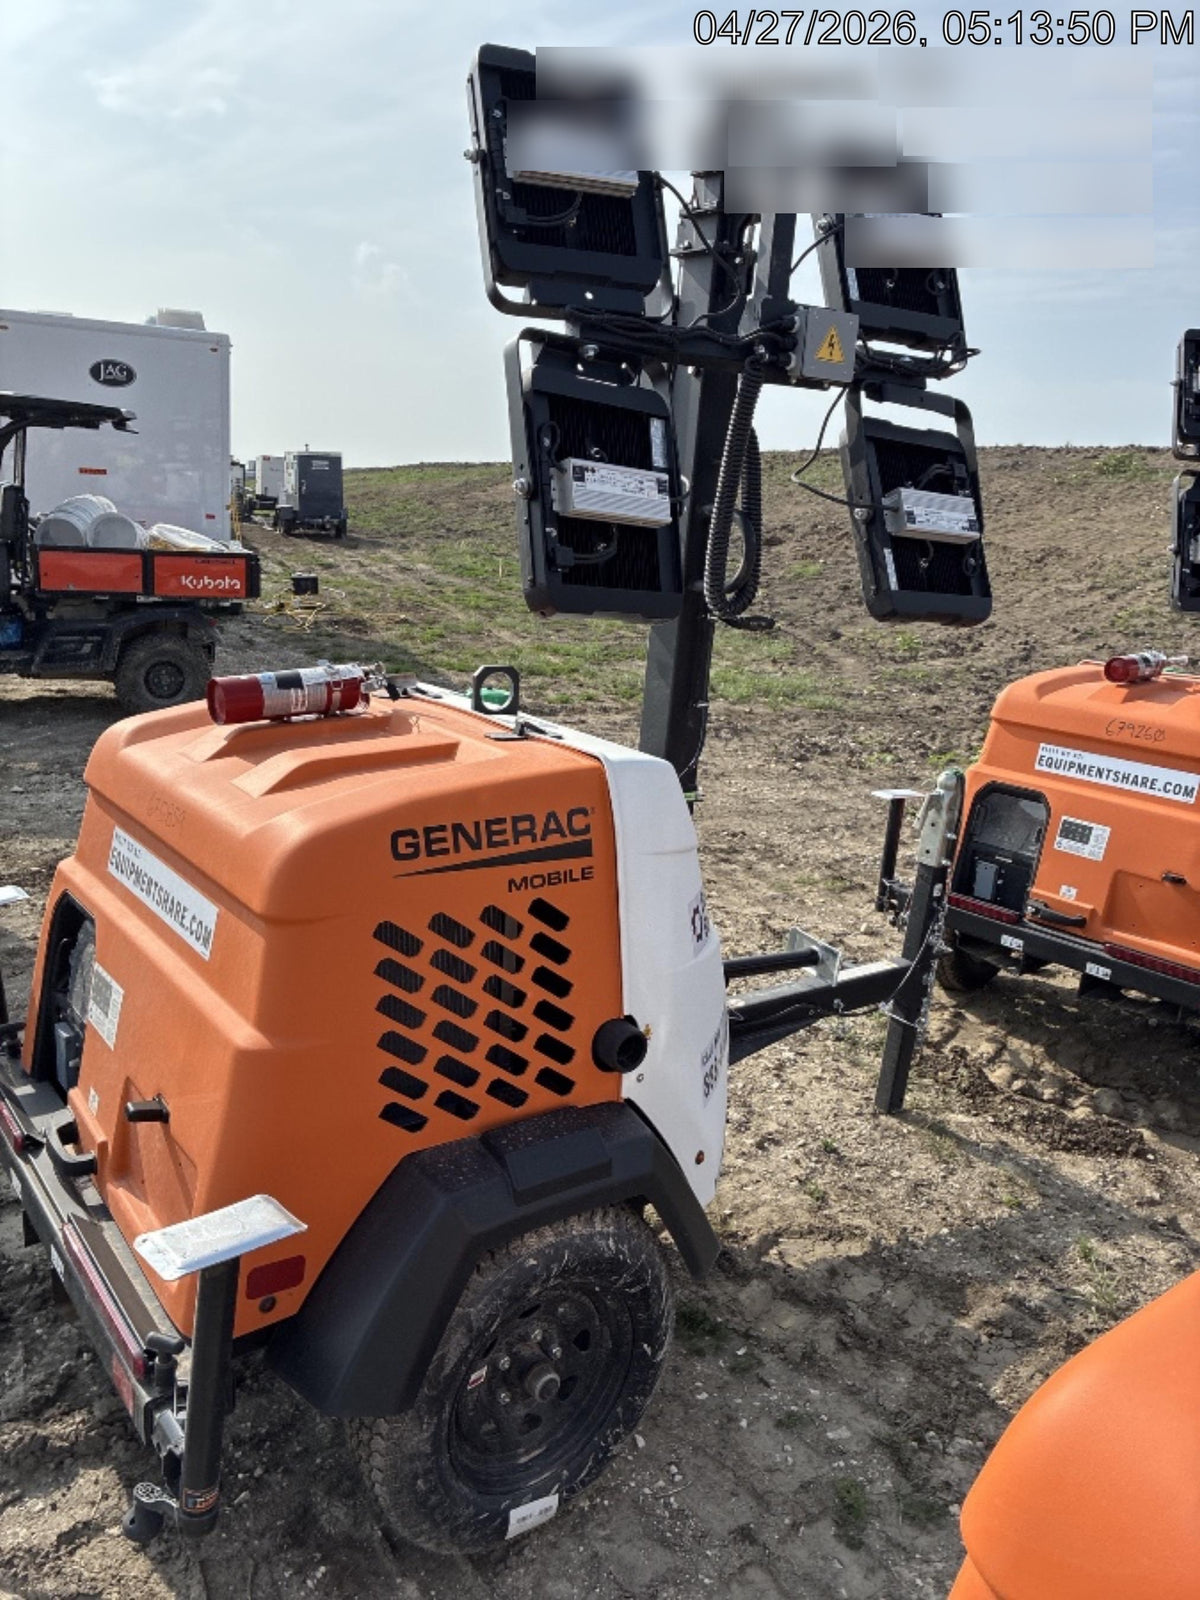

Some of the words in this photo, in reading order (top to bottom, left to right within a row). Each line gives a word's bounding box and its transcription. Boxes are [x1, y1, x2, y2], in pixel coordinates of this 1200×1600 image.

[181, 575, 241, 590] Kubota
[1037, 754, 1196, 799] EQUIPMENTSHARE.COM
[390, 806, 592, 862] GENERAC
[109, 847, 212, 949] EQUIPMENTSHARE.COM
[507, 865, 595, 893] MOBILE
